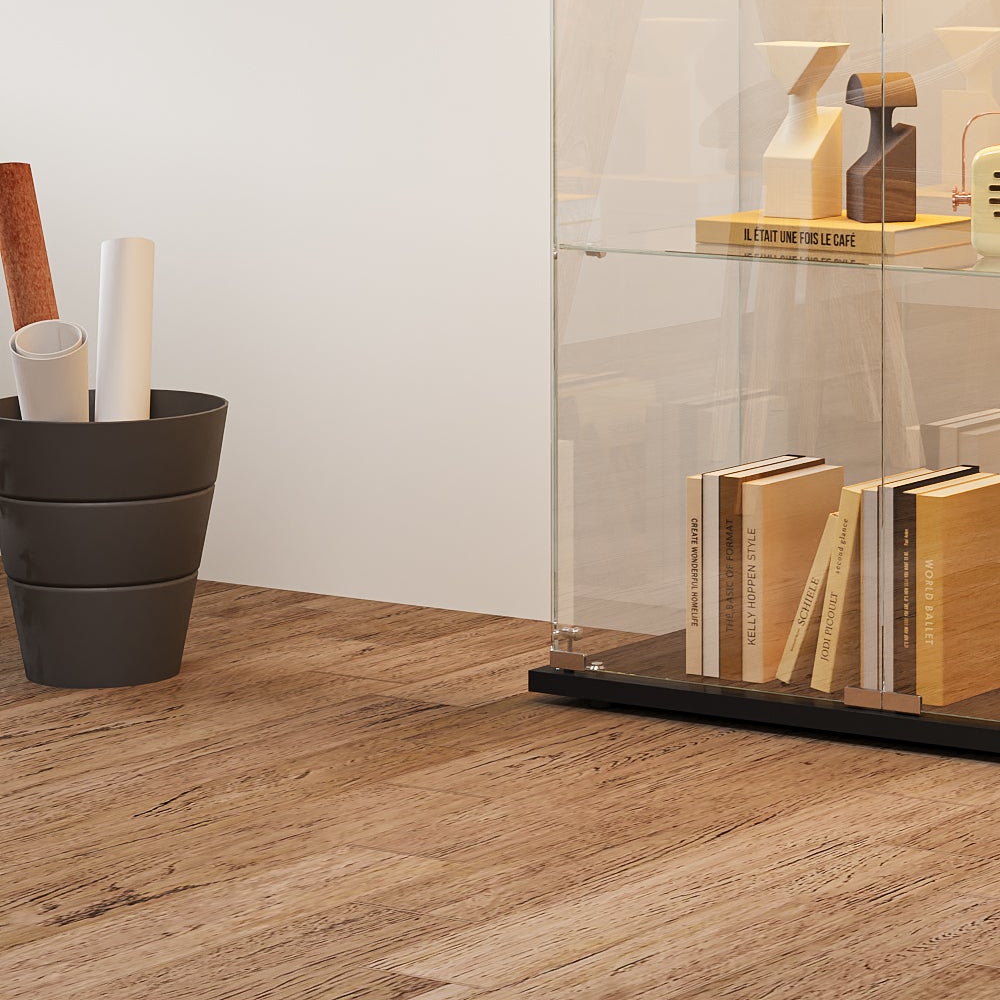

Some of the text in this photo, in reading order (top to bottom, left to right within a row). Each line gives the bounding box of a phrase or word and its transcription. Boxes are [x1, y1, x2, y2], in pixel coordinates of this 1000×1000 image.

[743, 225, 856, 248] IL ÉTAIT UNE FOIS LE CAFÉ
[725, 518, 735, 561] FORMAT
[835, 518, 849, 574] second glance
[690, 517, 699, 627] CREATE WONDERFUL HOMELIFE
[725, 564, 735, 578] OF
[725, 581, 735, 610] BASIC
[746, 527, 757, 646] KELLY HOPPEN STYLE
[797, 576, 820, 627] SCHIELE
[820, 591, 839, 662] JODI PICOULT
[924, 559, 934, 646] WORLD BALLET
